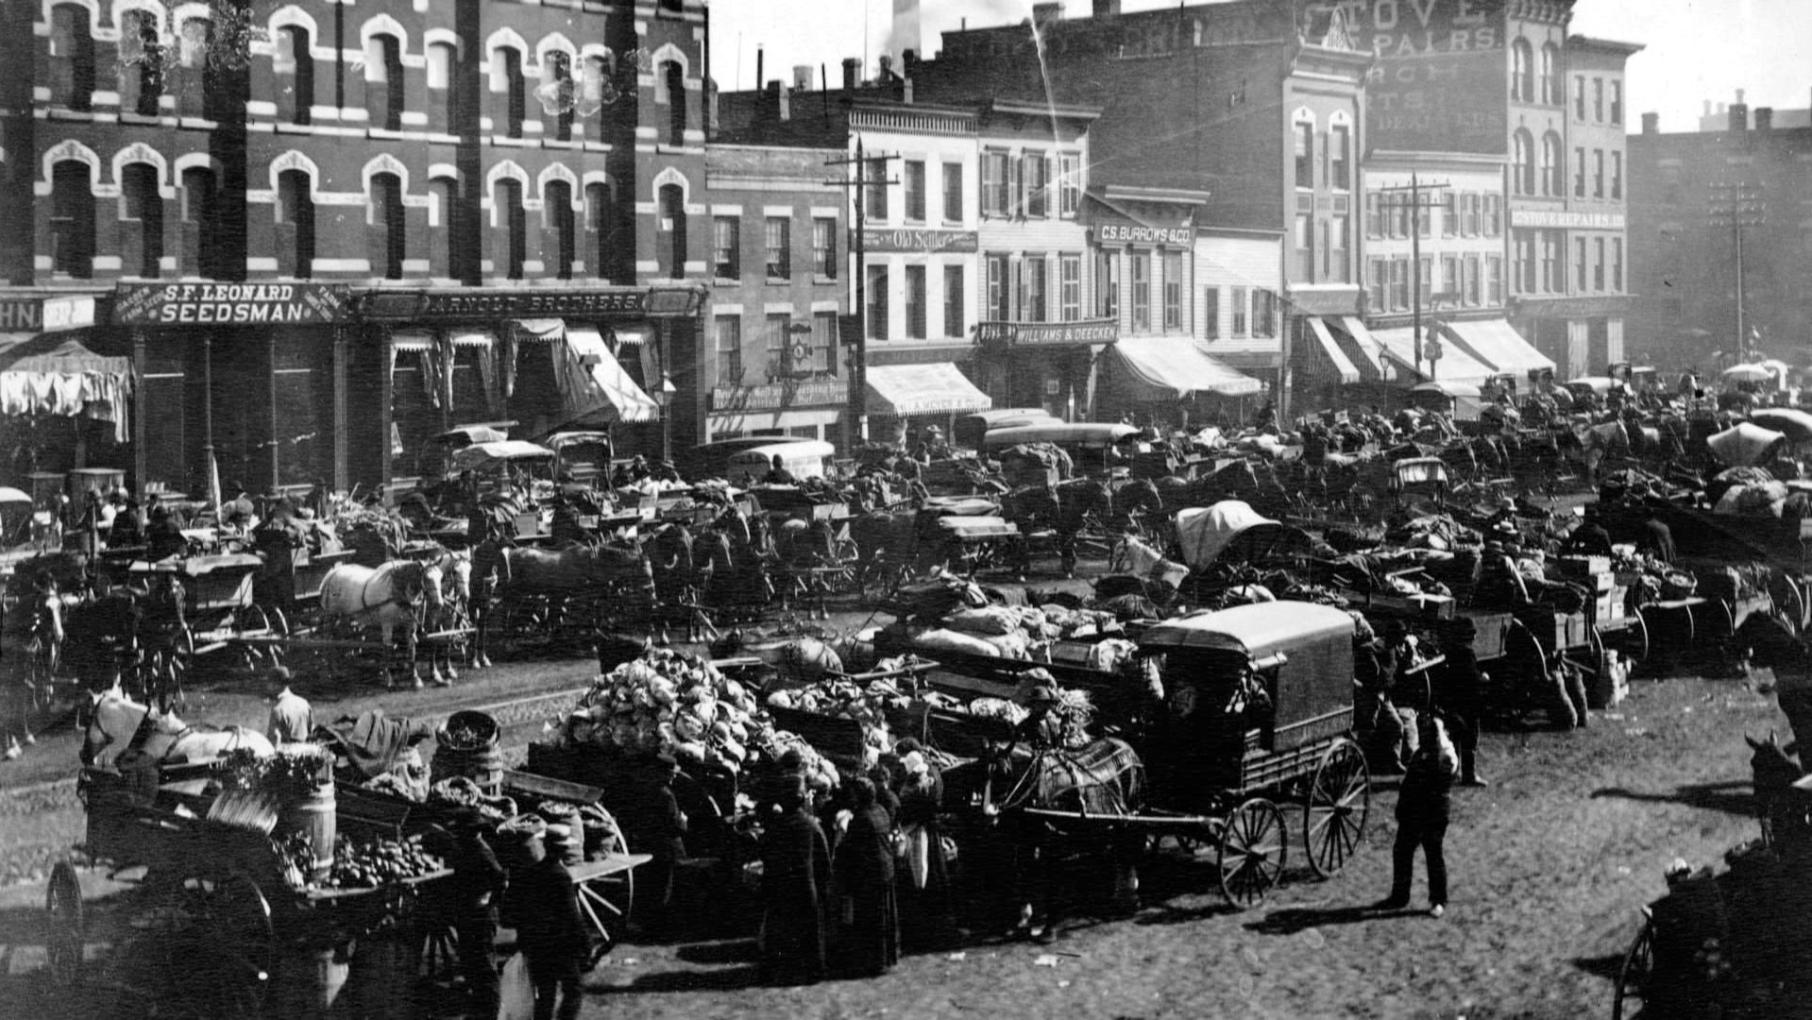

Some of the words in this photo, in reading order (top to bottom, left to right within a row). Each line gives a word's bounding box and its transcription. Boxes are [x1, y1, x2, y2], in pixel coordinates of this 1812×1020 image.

[1119, 226, 1167, 243] BURROWS
[200, 284, 293, 301] LEONARD
[160, 303, 303, 322] SEEDSMAN
